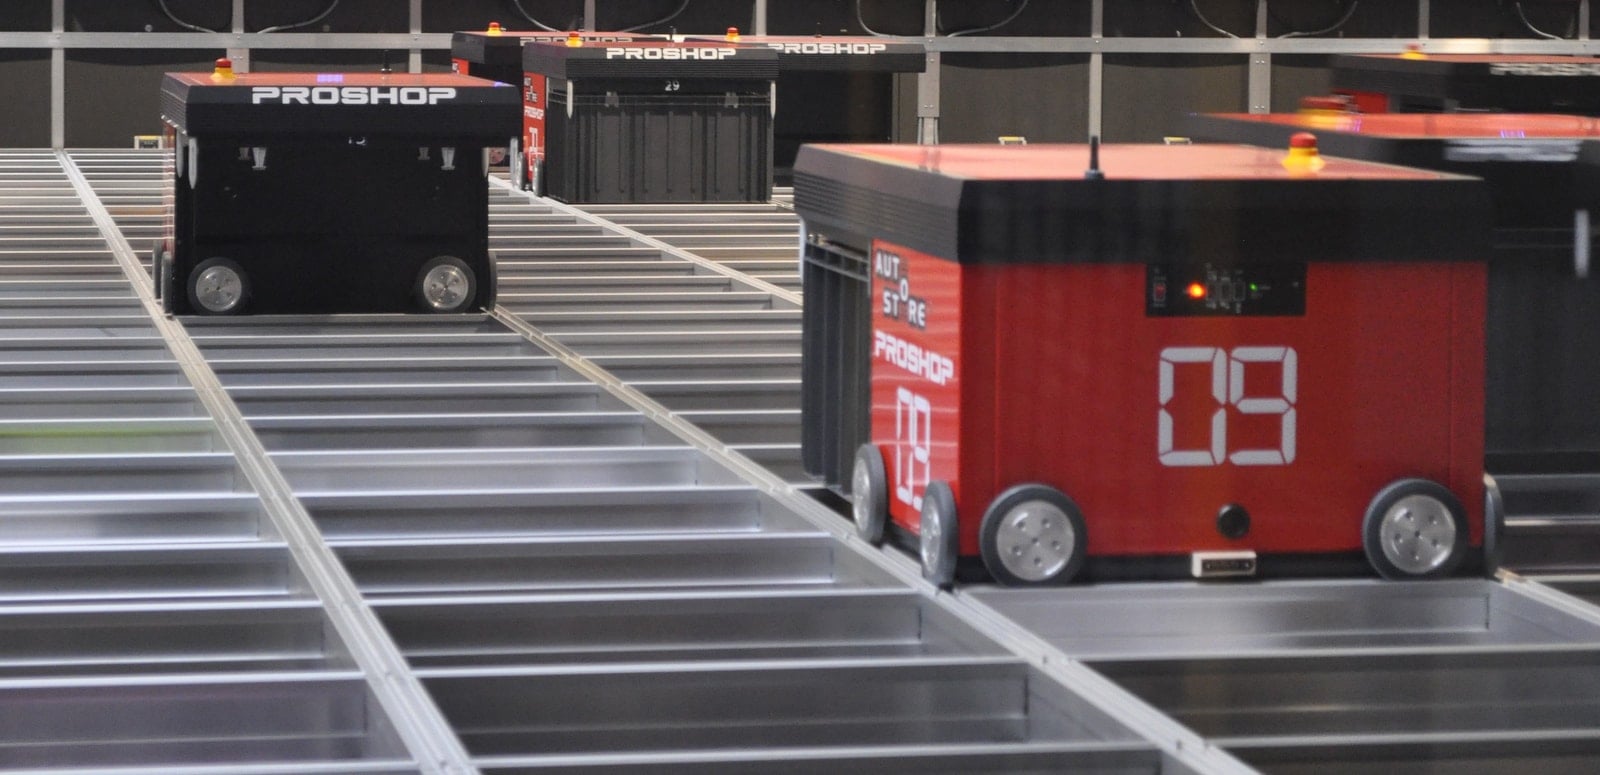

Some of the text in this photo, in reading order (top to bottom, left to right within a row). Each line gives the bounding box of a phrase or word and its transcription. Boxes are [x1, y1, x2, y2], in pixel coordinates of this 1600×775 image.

[606, 47, 736, 60] PROSHOP
[768, 43, 887, 54] PROSHOP
[665, 80, 680, 91] 29
[252, 86, 456, 105] PROSHOP
[875, 329, 954, 386] PROSHOP
[1158, 346, 1297, 467] 09
[896, 386, 931, 512] 09
